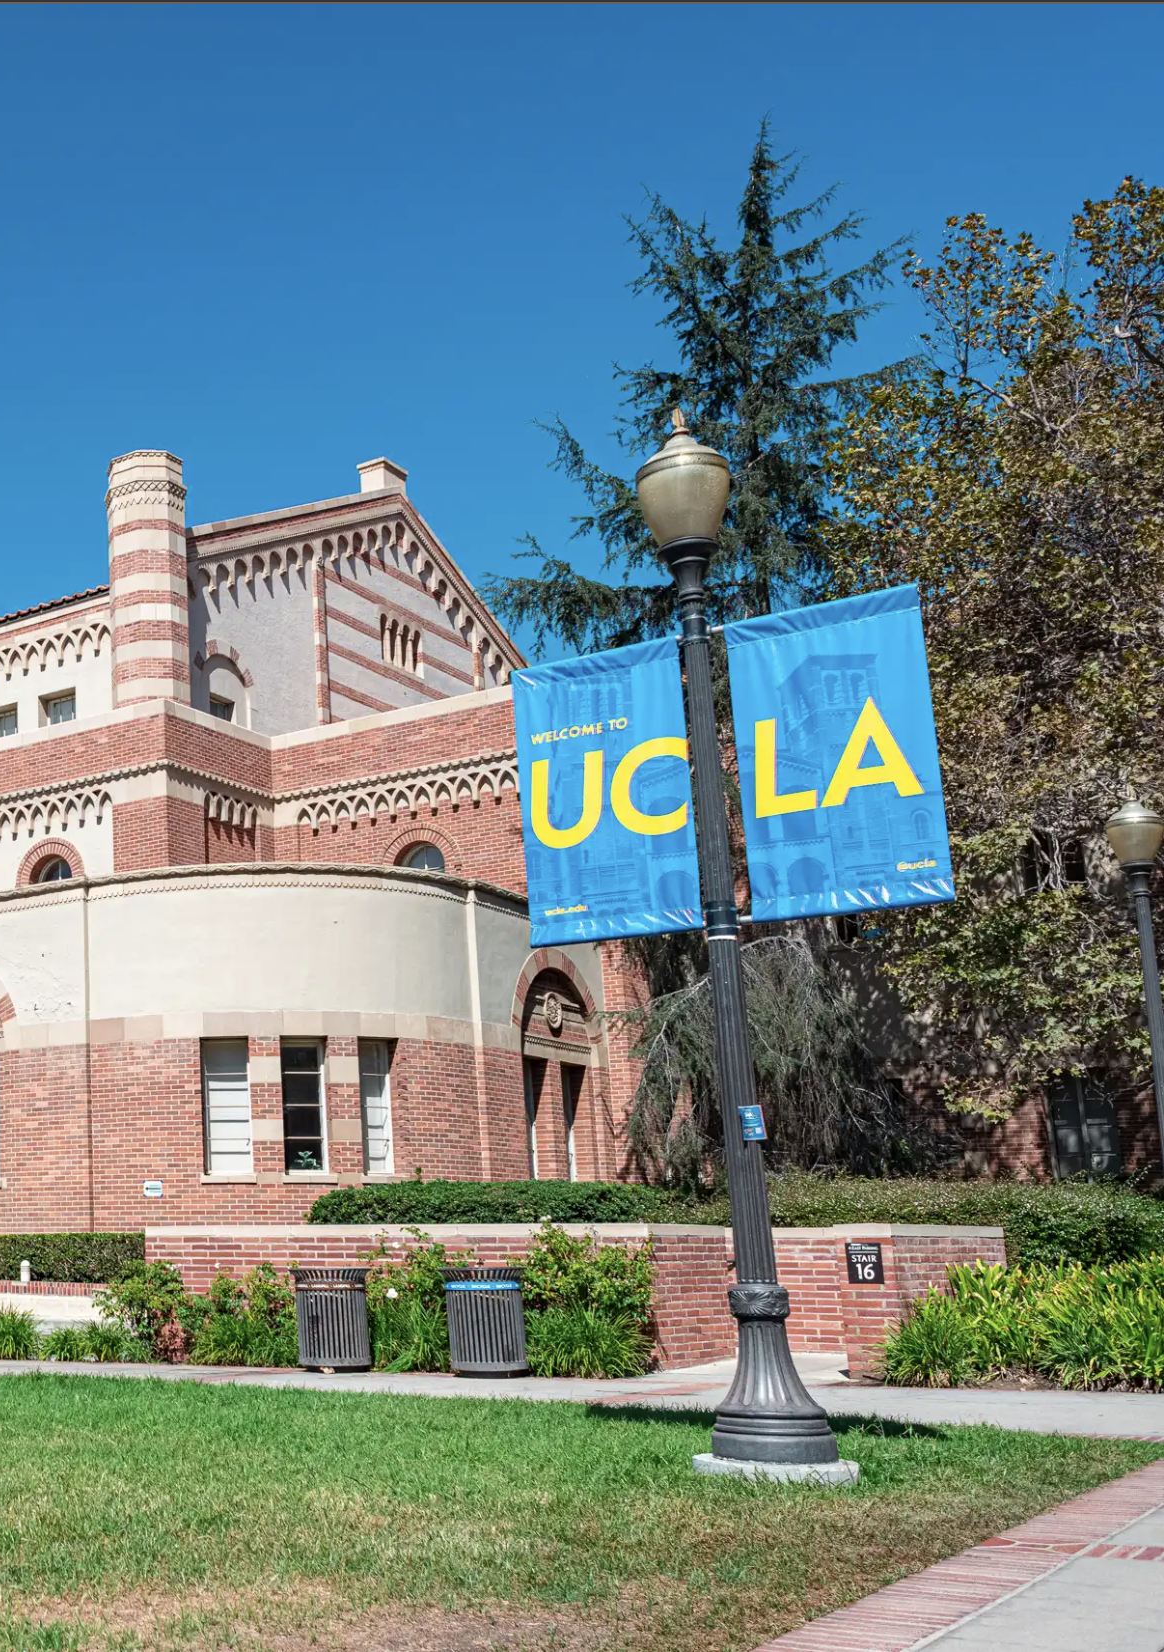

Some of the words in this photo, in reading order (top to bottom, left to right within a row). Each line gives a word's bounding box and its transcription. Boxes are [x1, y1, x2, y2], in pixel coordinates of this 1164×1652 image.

[530, 721, 604, 746] WELCOME
[608, 717, 629, 731] TO
[754, 695, 926, 819] LA
[530, 736, 689, 850] UC
[896, 858, 938, 873] @ucla
[544, 903, 589, 917] ucla.edu
[851, 1254, 877, 1262] STAIR
[855, 1263, 875, 1280] 16
